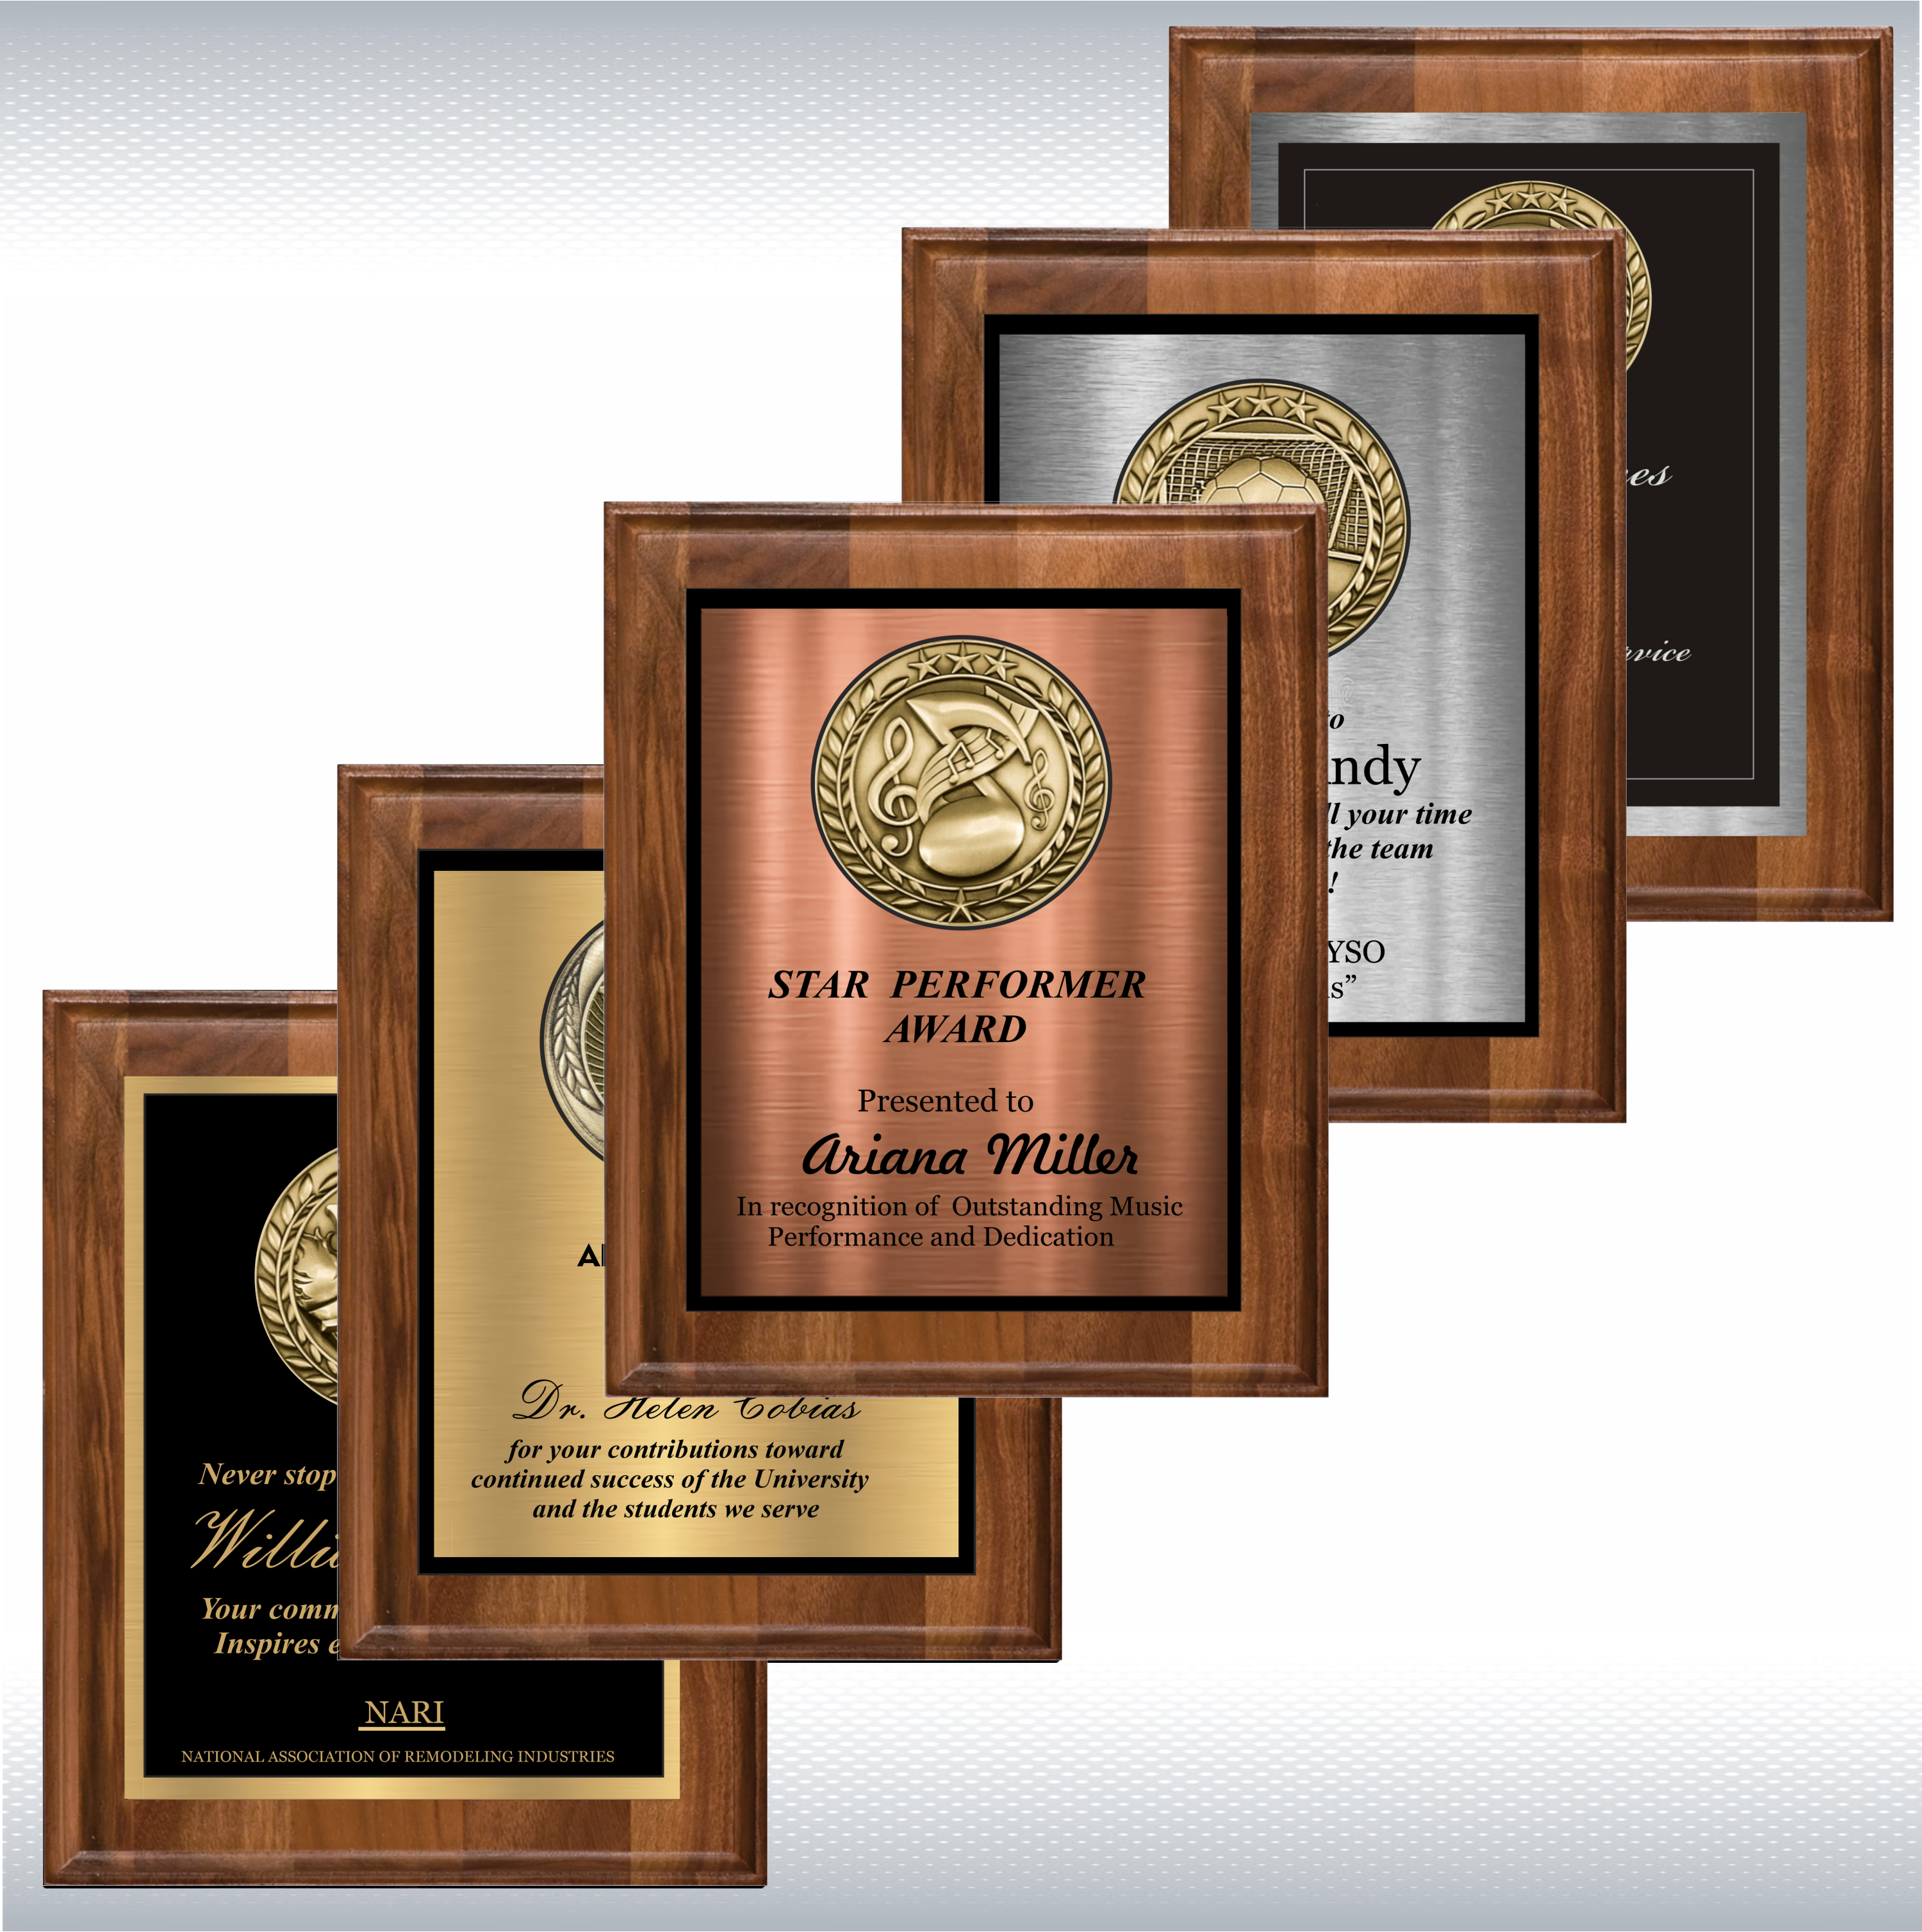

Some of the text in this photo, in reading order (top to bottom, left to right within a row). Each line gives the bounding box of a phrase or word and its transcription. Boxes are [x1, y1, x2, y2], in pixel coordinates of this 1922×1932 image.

[1627, 465, 1673, 486] es
[1328, 743, 1422, 796] ndy
[1344, 809, 1408, 830] your
[1416, 802, 1472, 825] time
[1371, 840, 1433, 859] team
[768, 970, 1146, 998] STAR PERFORMER
[882, 1014, 1026, 1043] AWARD
[858, 1087, 1033, 1112] Presented to
[802, 1133, 1138, 1175] Ariana Miller
[737, 1194, 1183, 1223] In recognition of Outstanding Music
[768, 1225, 1115, 1246] Performance and Dedication
[512, 1379, 585, 1419] Dr.
[504, 1439, 845, 1464] for your contributions toward
[197, 1463, 336, 1491] Never stop
[471, 1469, 869, 1494] continued success of the University
[532, 1499, 819, 1518] and the students we serve
[202, 1598, 261, 1620] Your
[213, 1631, 320, 1660] Inspires
[365, 1701, 444, 1724] NARI
[181, 1750, 614, 1763] NATIONAL ASSOCIATION OF REMODELING INDUSTRIES
